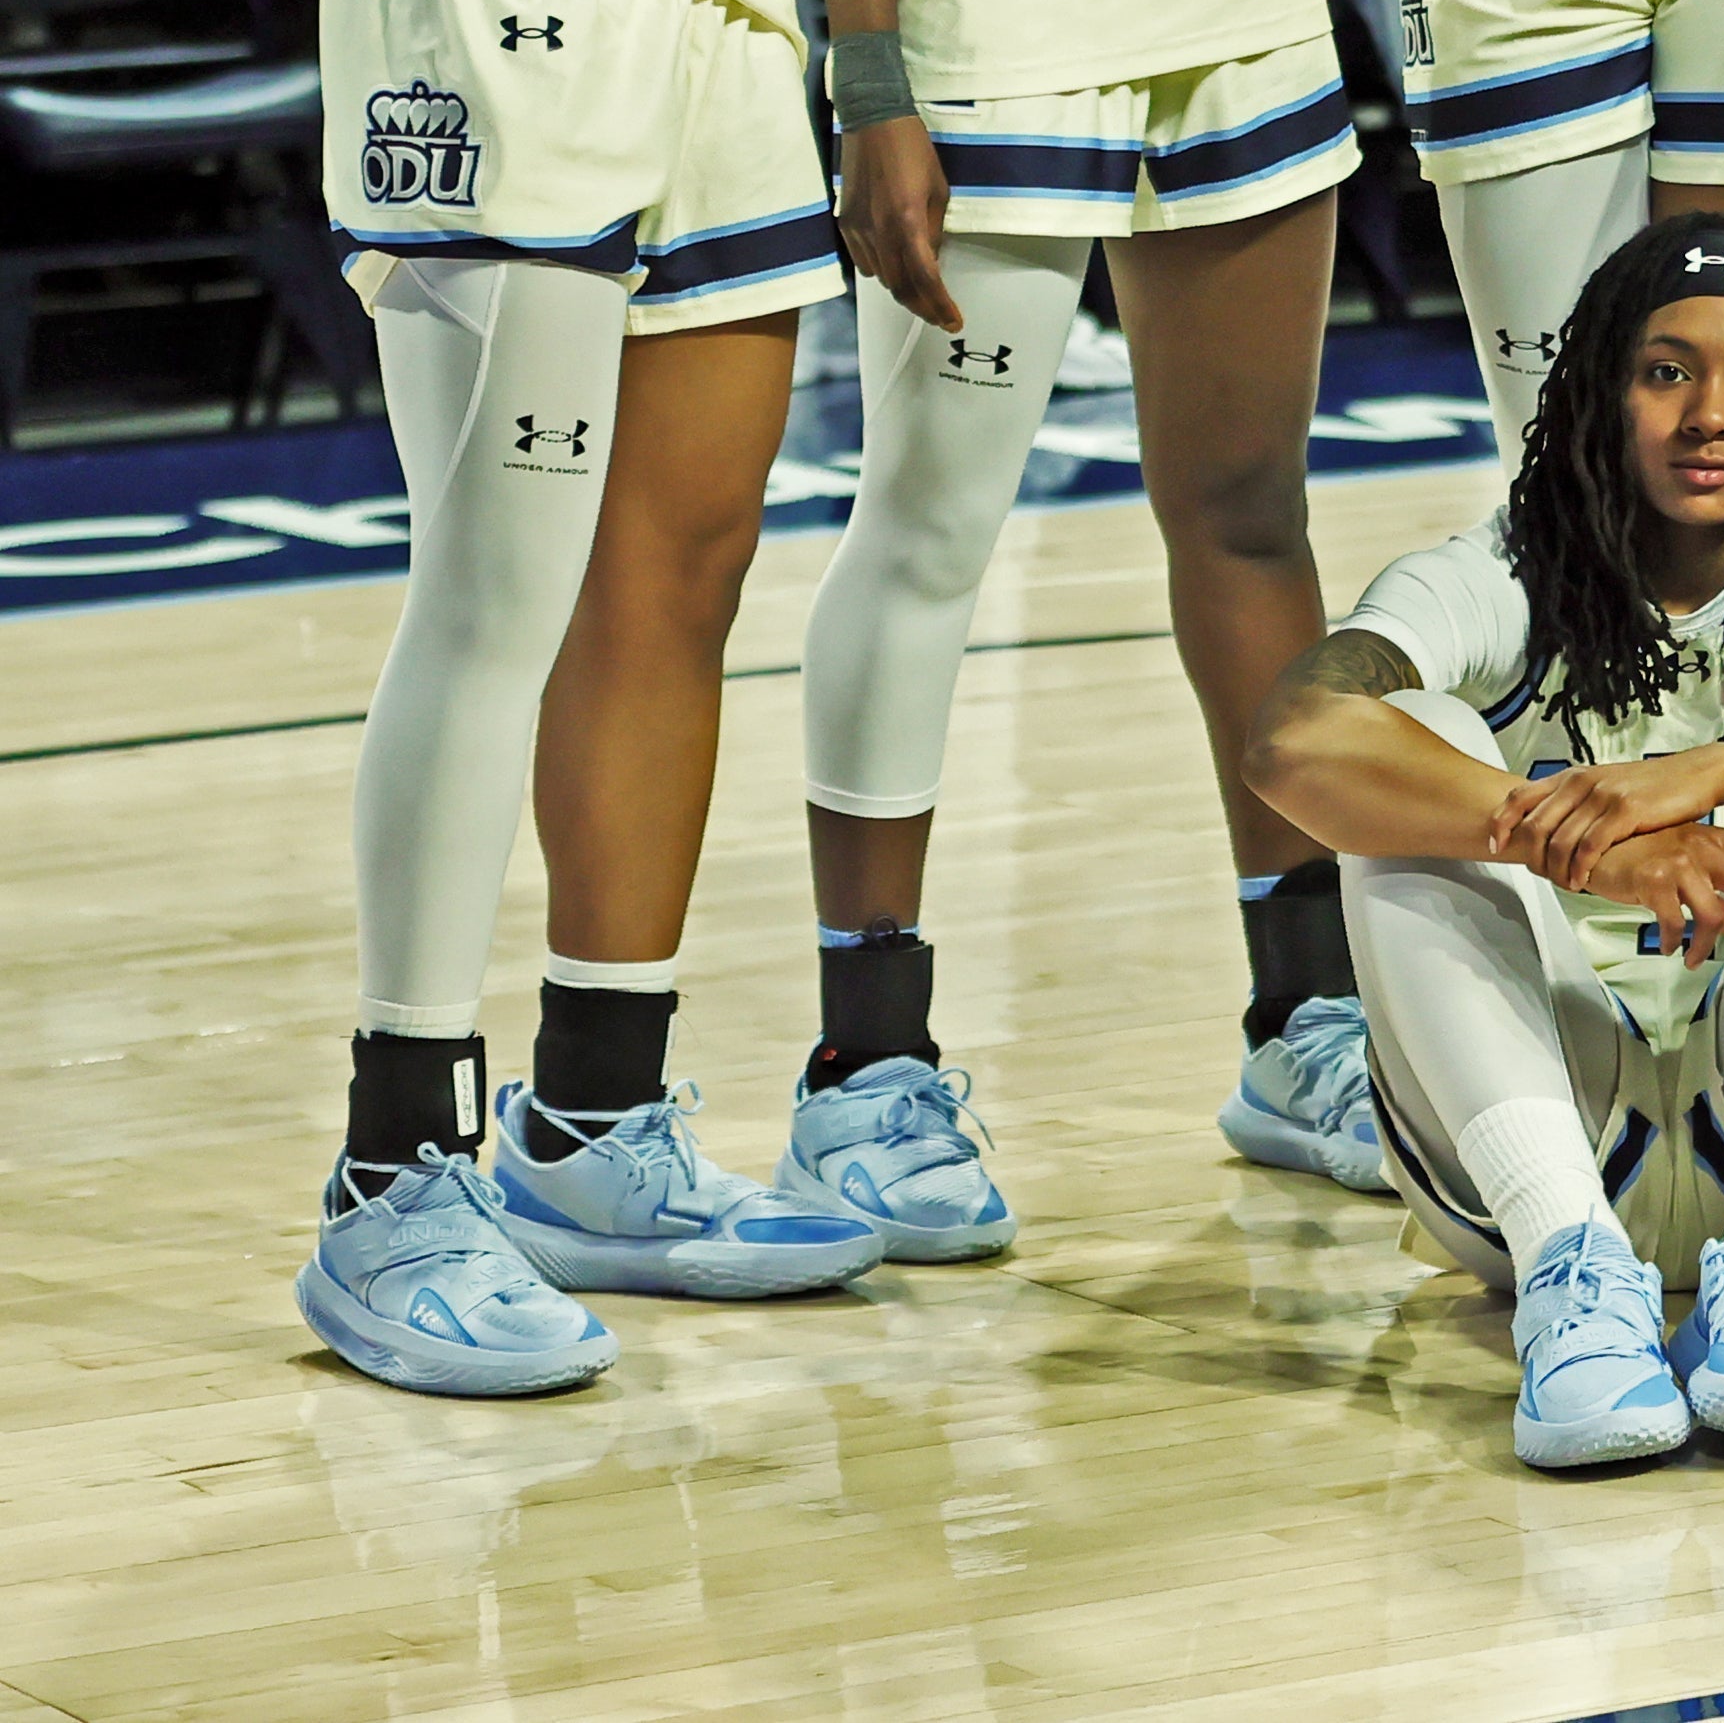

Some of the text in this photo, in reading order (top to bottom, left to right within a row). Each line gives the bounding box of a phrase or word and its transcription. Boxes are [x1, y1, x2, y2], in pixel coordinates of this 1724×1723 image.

[361, 137, 482, 208] ODU
[971, 378, 1014, 389] ARMOUR
[503, 460, 590, 475] UNDER ARMOUR
